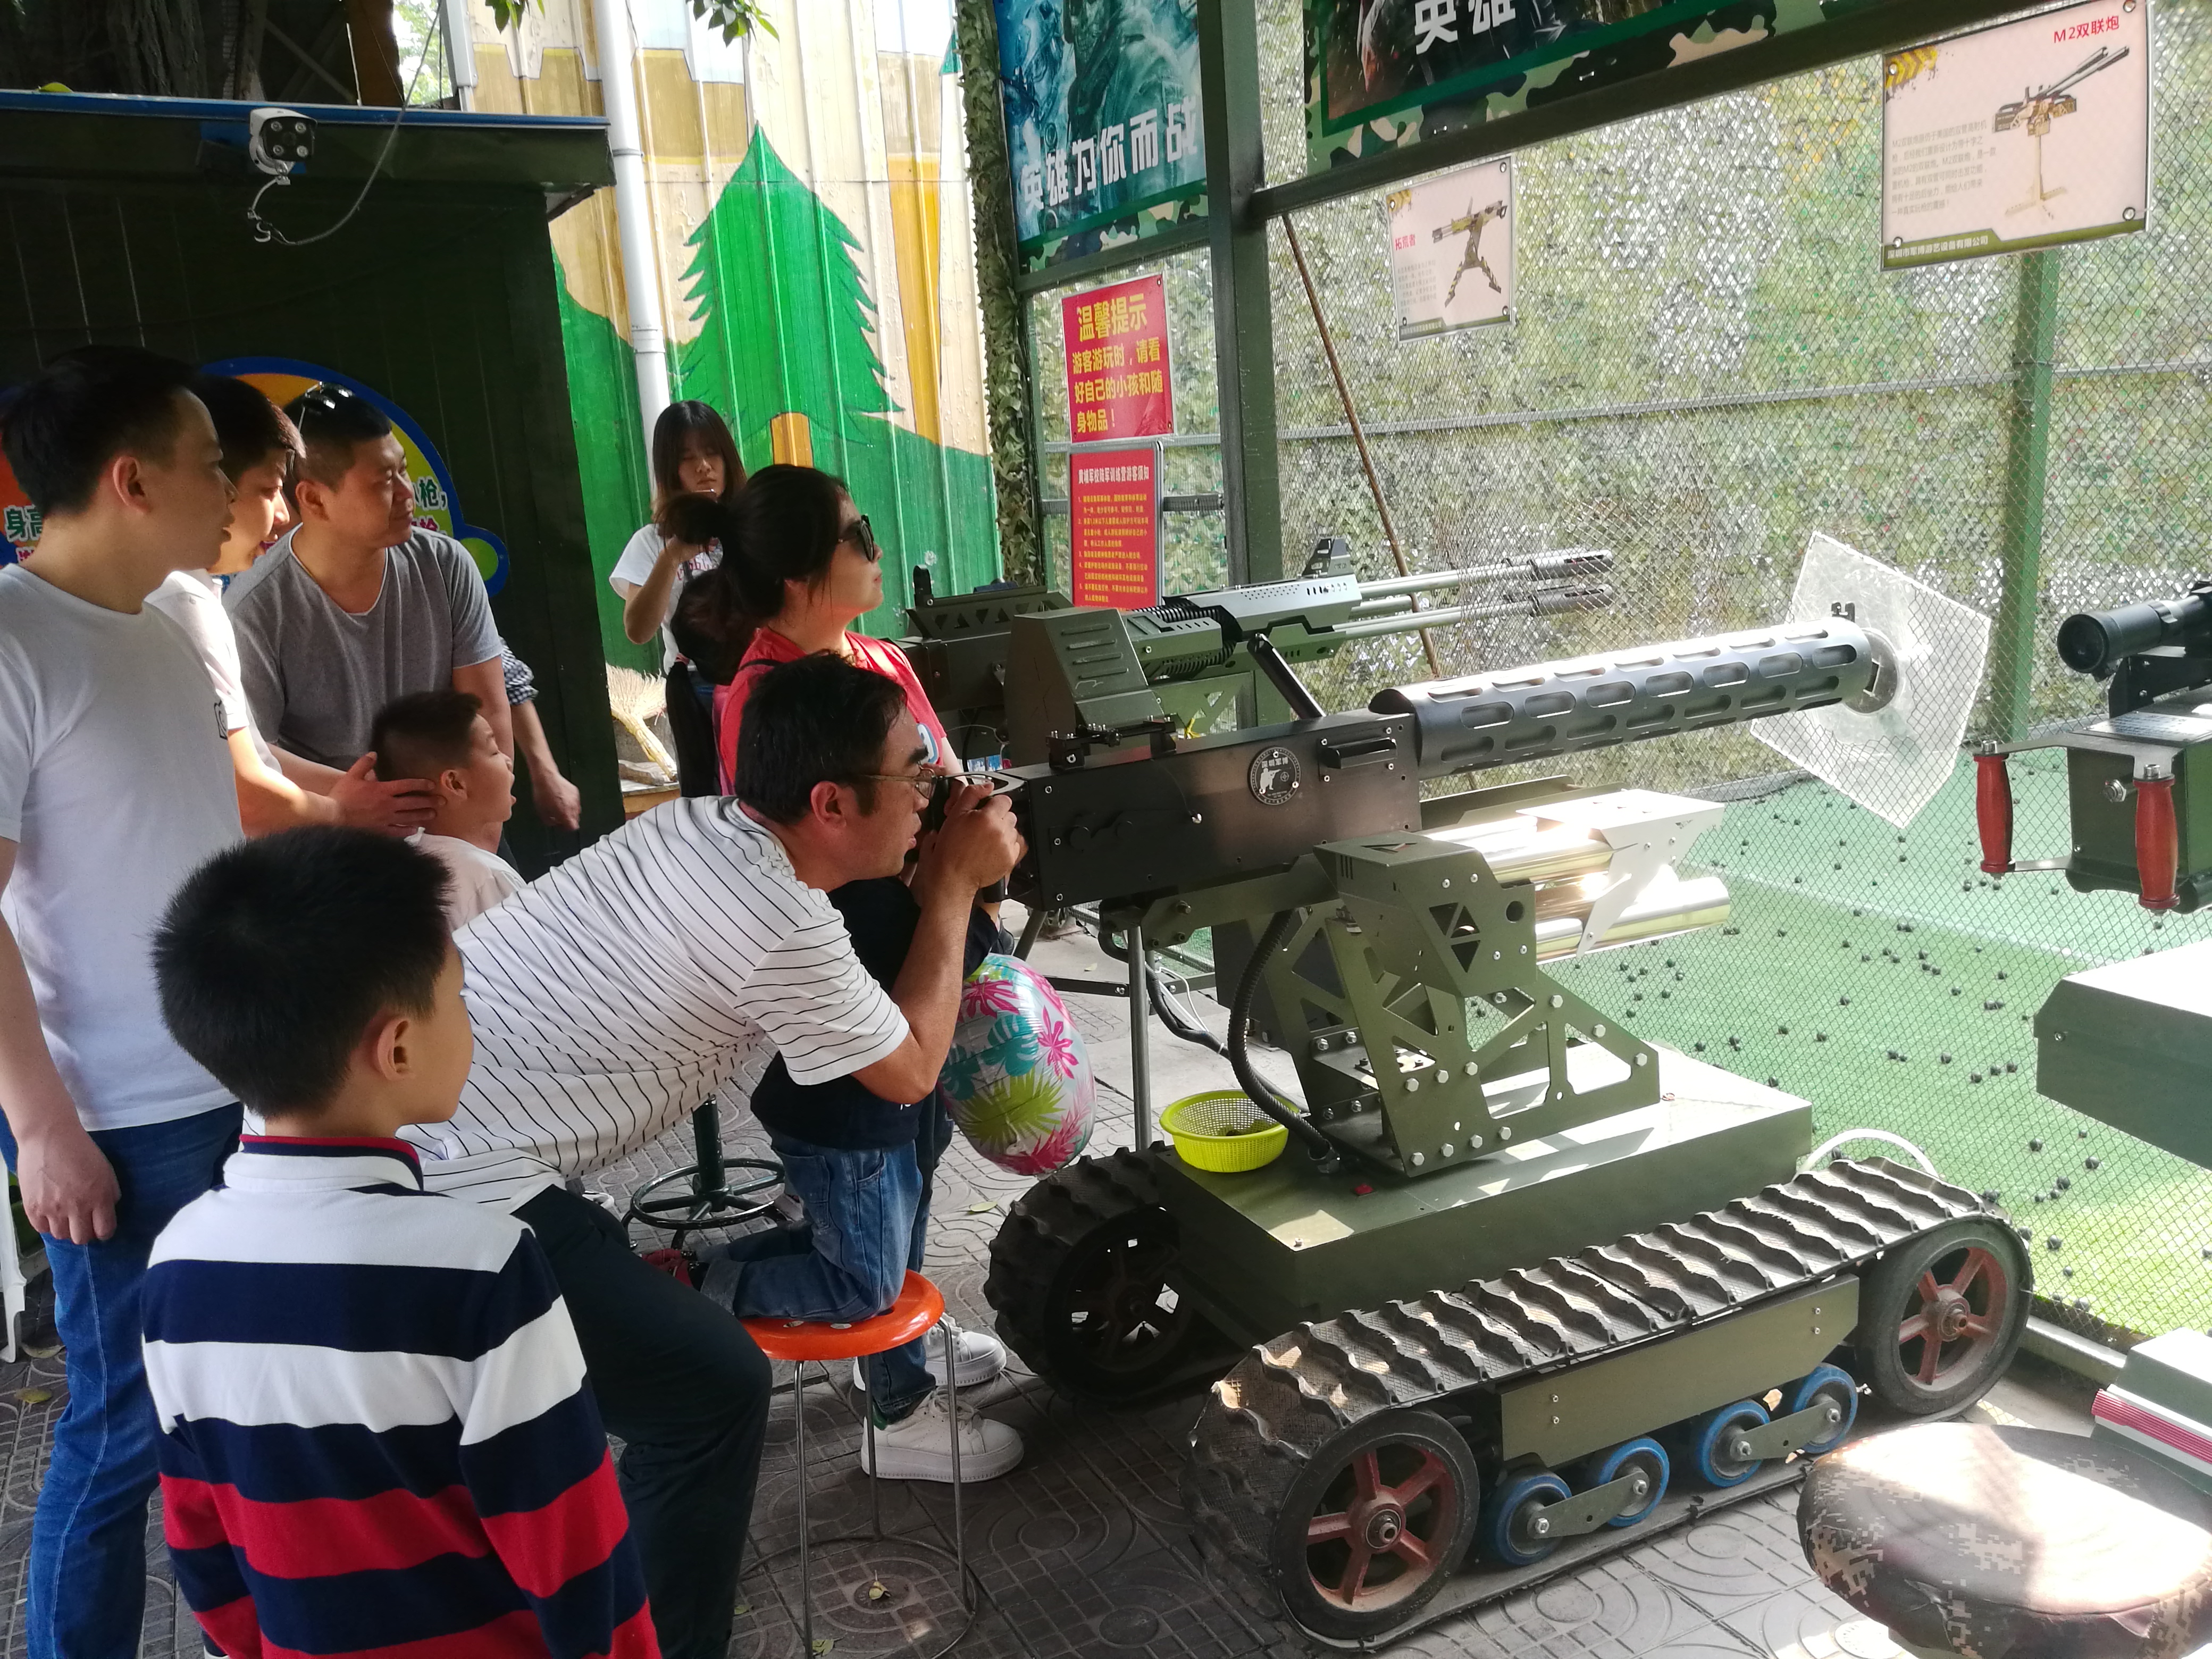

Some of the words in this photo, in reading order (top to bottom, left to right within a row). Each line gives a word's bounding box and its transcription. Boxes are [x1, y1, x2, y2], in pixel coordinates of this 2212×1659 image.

[1020, 96, 1197, 215] 英雄为你而战
[1077, 293, 1147, 342] 温馨提示
[1074, 368, 1163, 404] 好自己的小孩和随
[413, 476, 447, 510] 枪，
